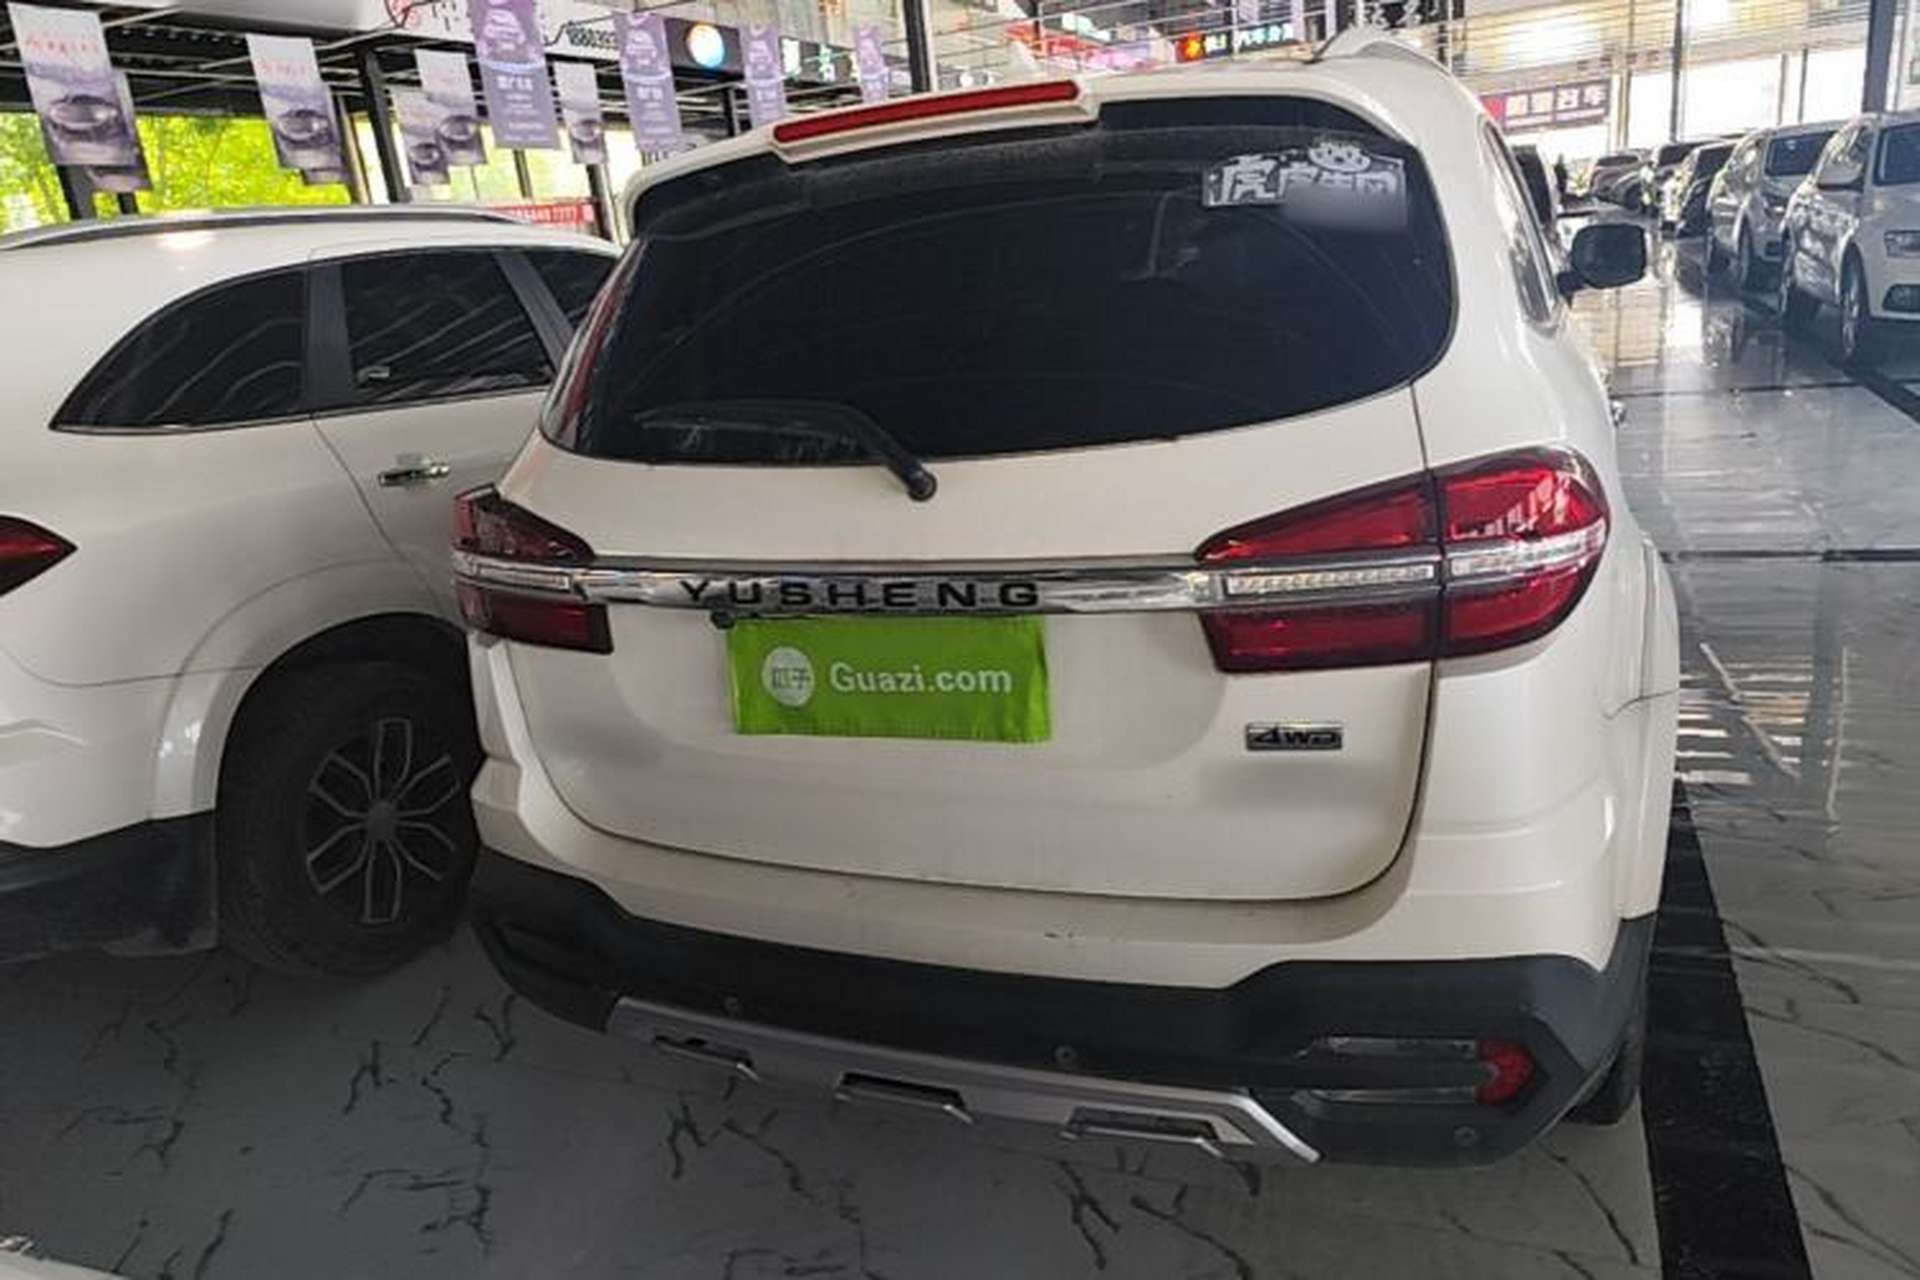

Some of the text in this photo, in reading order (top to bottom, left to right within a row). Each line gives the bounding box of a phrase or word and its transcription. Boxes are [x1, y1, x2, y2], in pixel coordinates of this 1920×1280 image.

[680, 580, 1040, 608] YUSHENG
[829, 661, 1012, 693] Guazi.com
[1248, 725, 1341, 750] 4WD
